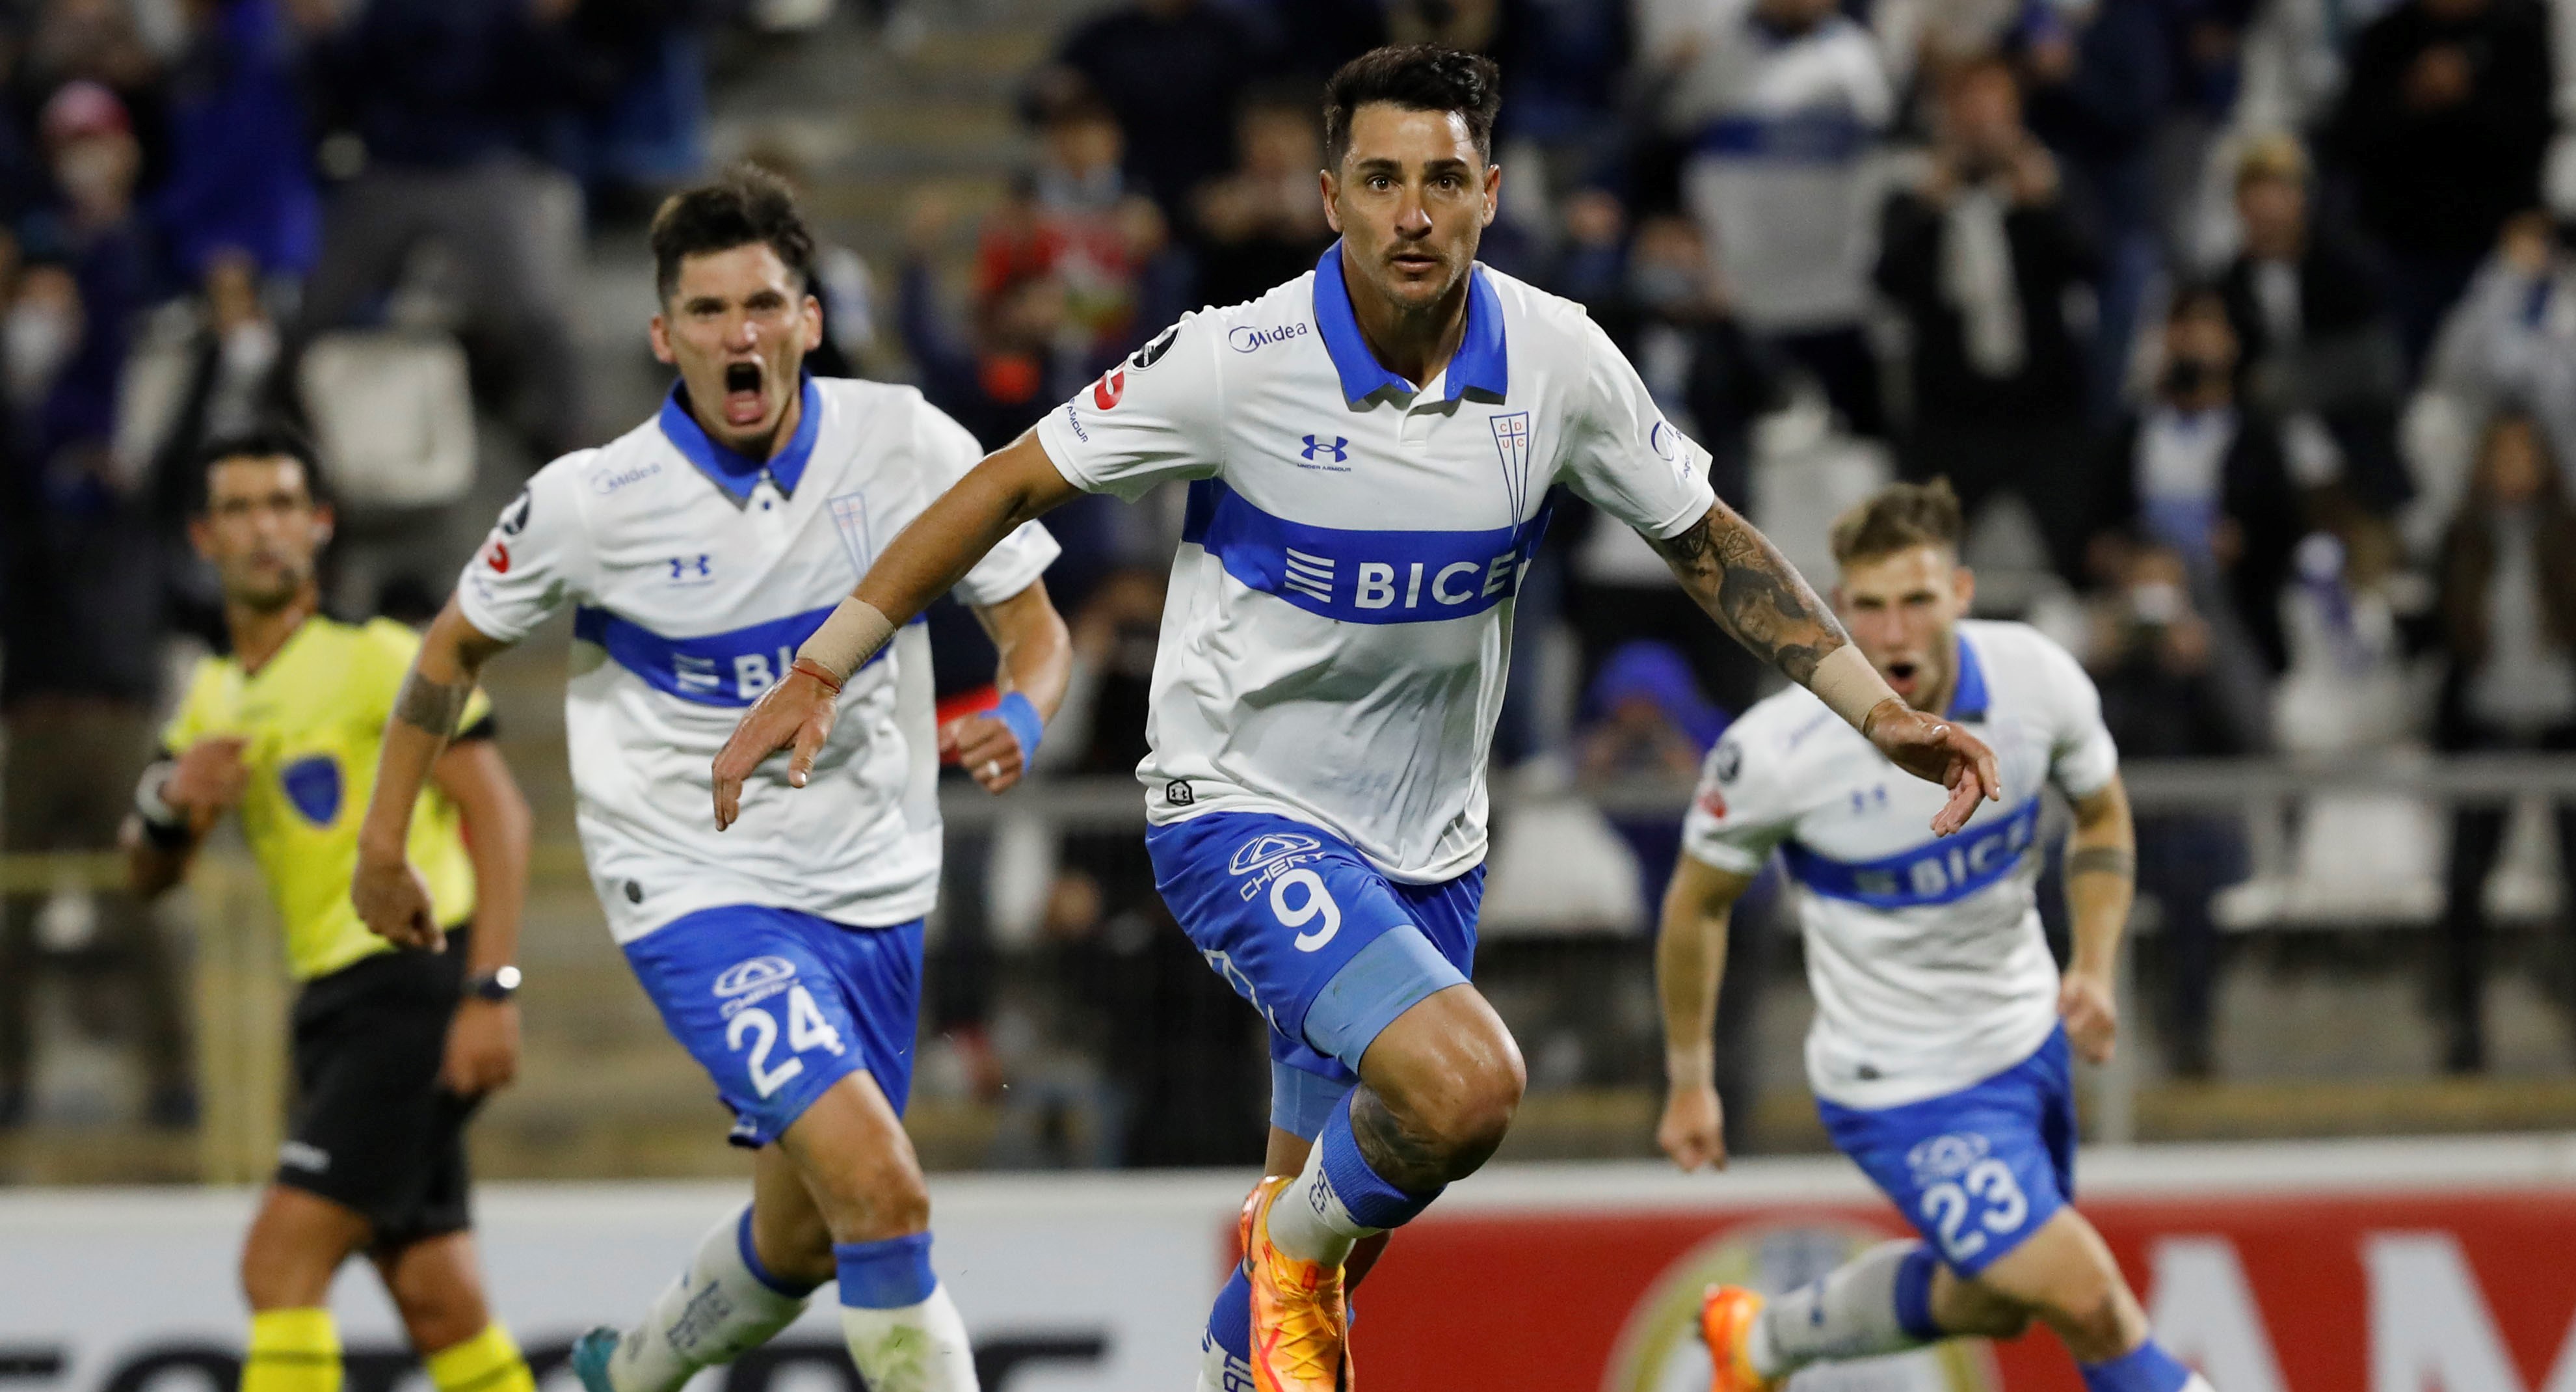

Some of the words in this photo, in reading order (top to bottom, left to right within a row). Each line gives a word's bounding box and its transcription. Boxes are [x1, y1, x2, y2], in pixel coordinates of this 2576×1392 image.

[1228, 323, 1307, 353] Midea
[1355, 550, 1516, 609] BICE
[1240, 851, 1326, 902] CHERY
[1270, 868, 1342, 952] 9
[726, 984, 845, 1099] 24
[1921, 1158, 2028, 1261] 23
